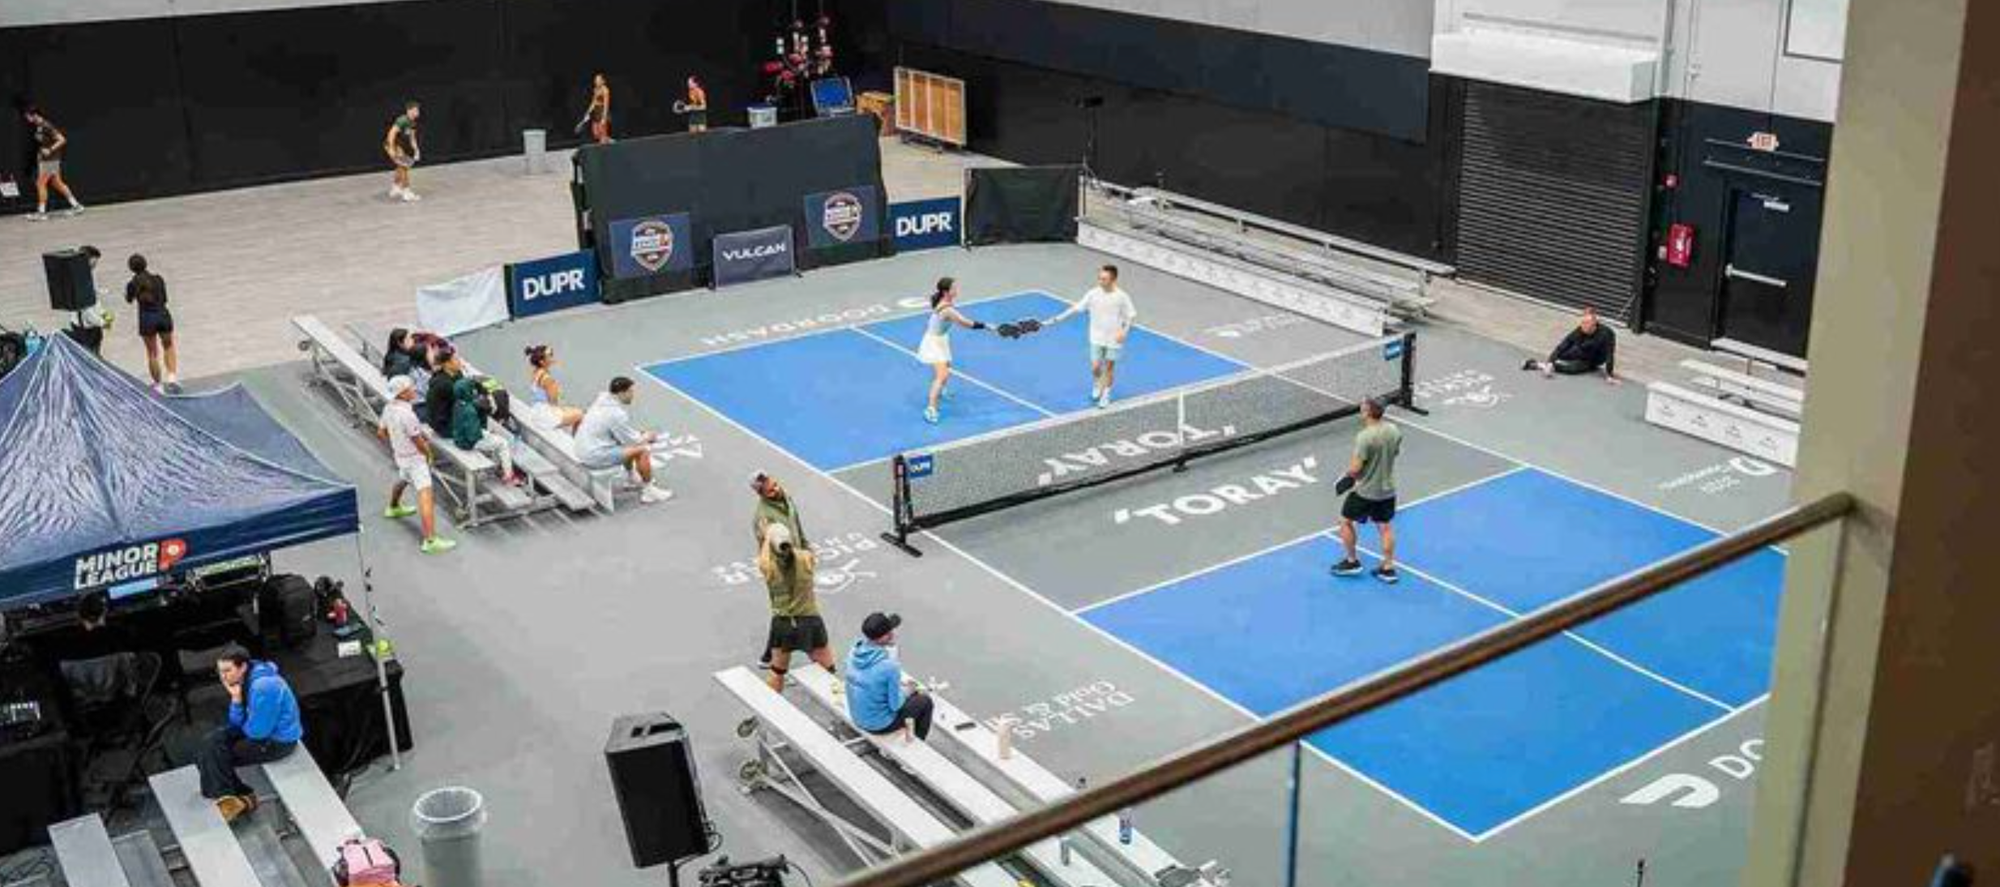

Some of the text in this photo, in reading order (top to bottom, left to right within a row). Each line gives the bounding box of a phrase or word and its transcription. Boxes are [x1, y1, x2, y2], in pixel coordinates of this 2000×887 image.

[895, 212, 953, 237] DUPR
[722, 243, 786, 261] VULCAN
[522, 268, 586, 300] DUPR
[76, 542, 159, 577] MINOR
[74, 560, 158, 591] LEAGUE
[1012, 691, 1135, 739] DALLAS
